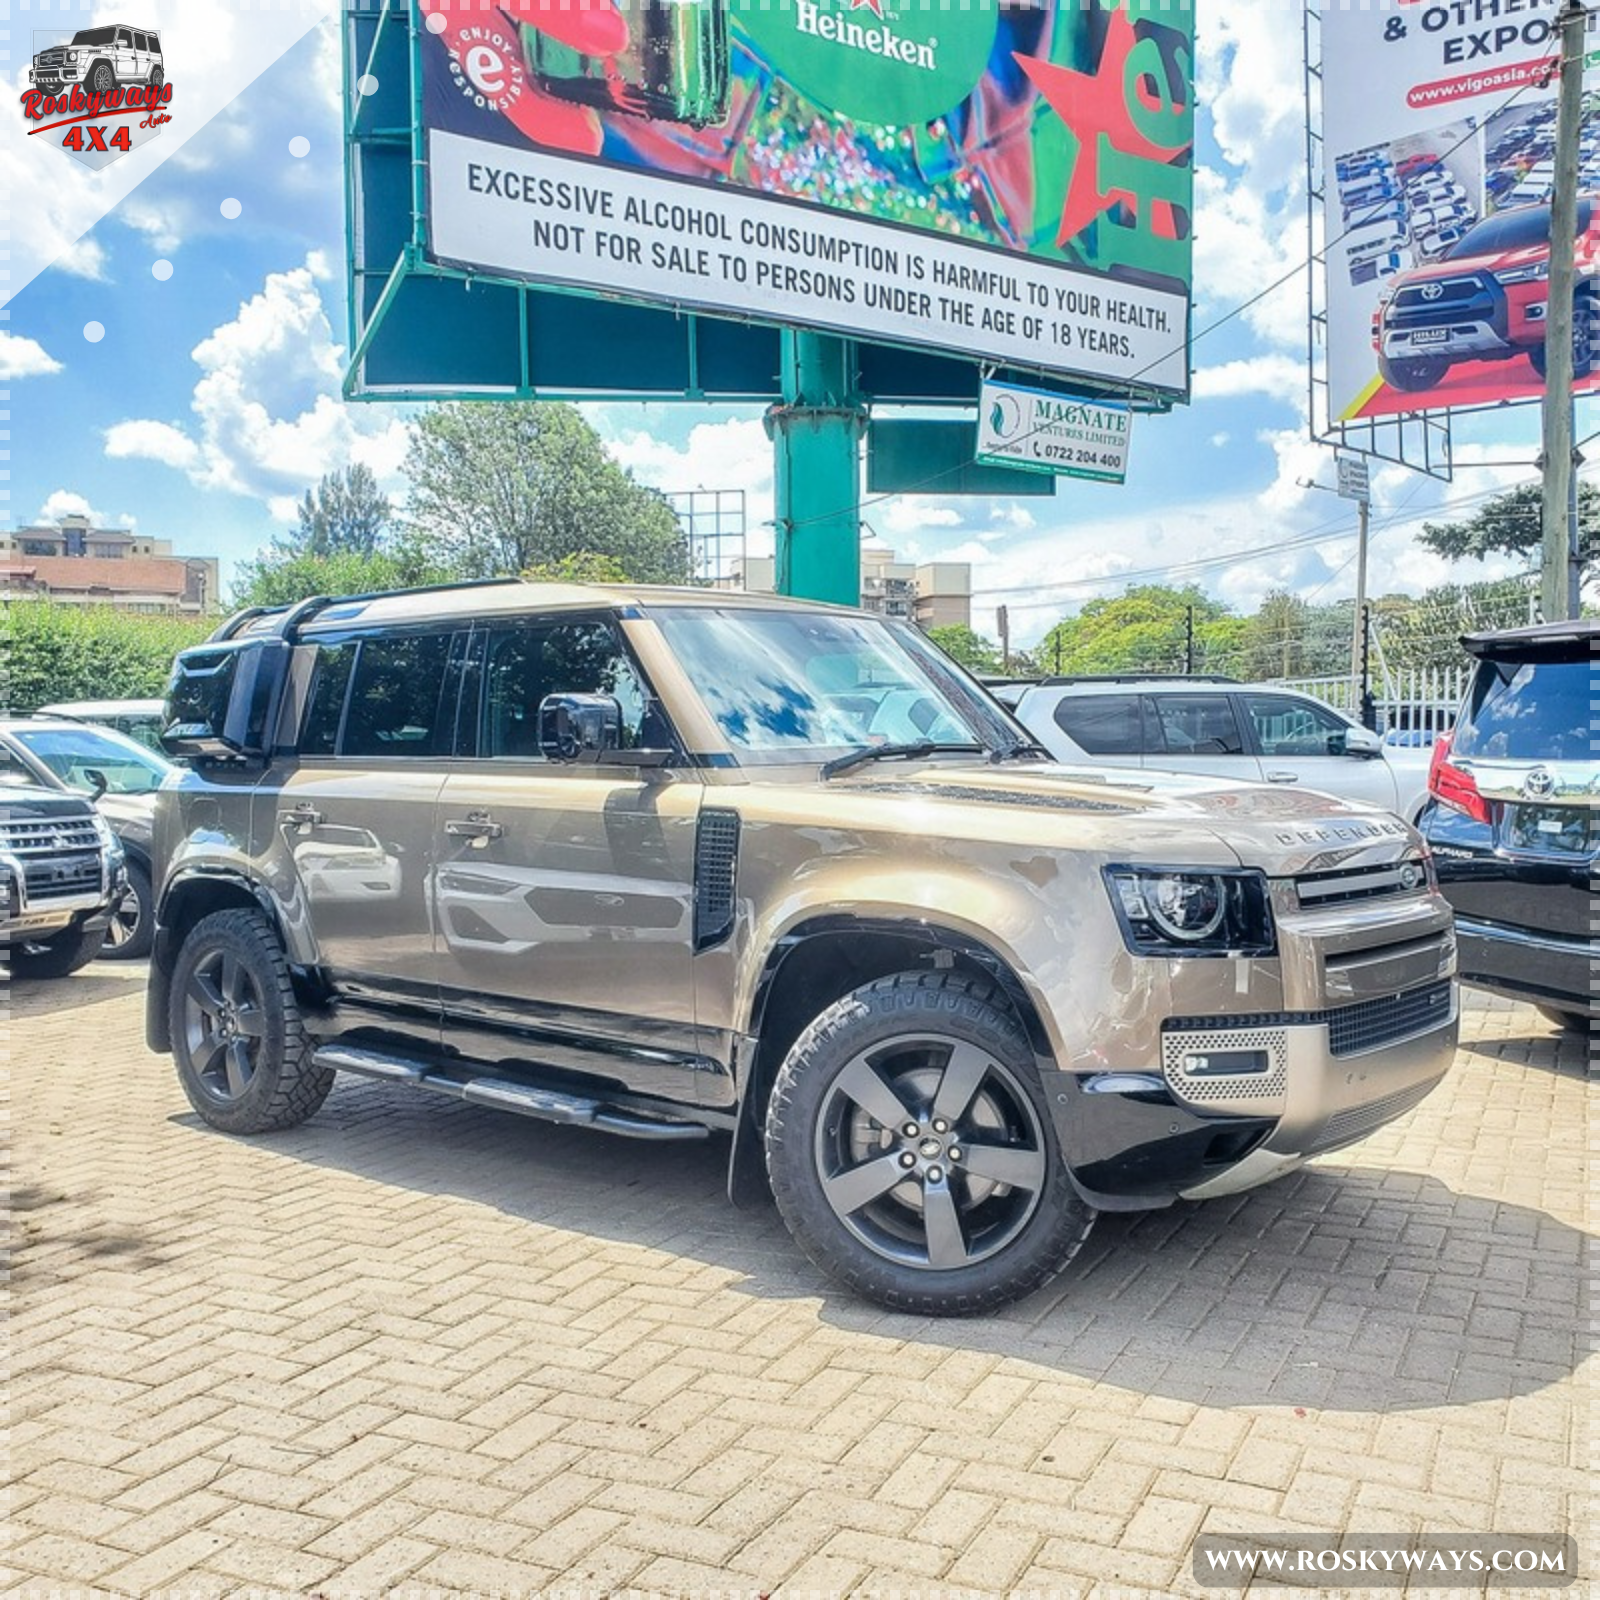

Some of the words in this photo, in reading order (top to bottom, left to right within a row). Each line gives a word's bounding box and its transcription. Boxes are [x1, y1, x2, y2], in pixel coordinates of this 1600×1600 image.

[796, 0, 937, 70] Heineken
[1383, 15, 1408, 42] &
[467, 163, 614, 219] EXCESSIVE
[623, 196, 732, 241] ALCOHOL
[740, 218, 899, 275] CONSUMPTION
[905, 253, 926, 281] IS
[933, 260, 1022, 302] HARMFUL
[1027, 281, 1049, 308] TO
[1055, 287, 1101, 319] YOUR
[1106, 299, 1172, 334] HEALTH.
[533, 219, 585, 255] NOT
[595, 231, 643, 265] FOR
[651, 242, 710, 277] SALE
[718, 253, 748, 283] TO
[756, 260, 856, 304] PERSONS
[864, 282, 932, 319] UNDER
[938, 297, 975, 327] THE
[981, 307, 1017, 336] AGE
[1022, 315, 1044, 341] OF
[1051, 321, 1072, 347] 18
[1077, 326, 1136, 359] YEARS.
[1035, 399, 1128, 433] MAGNATE
[1084, 431, 1126, 448] LIMITED
[1045, 443, 1074, 461] 0722
[1076, 449, 1098, 465] 204
[1100, 453, 1122, 469] 400
[1275, 821, 1409, 847] DEFENDER
